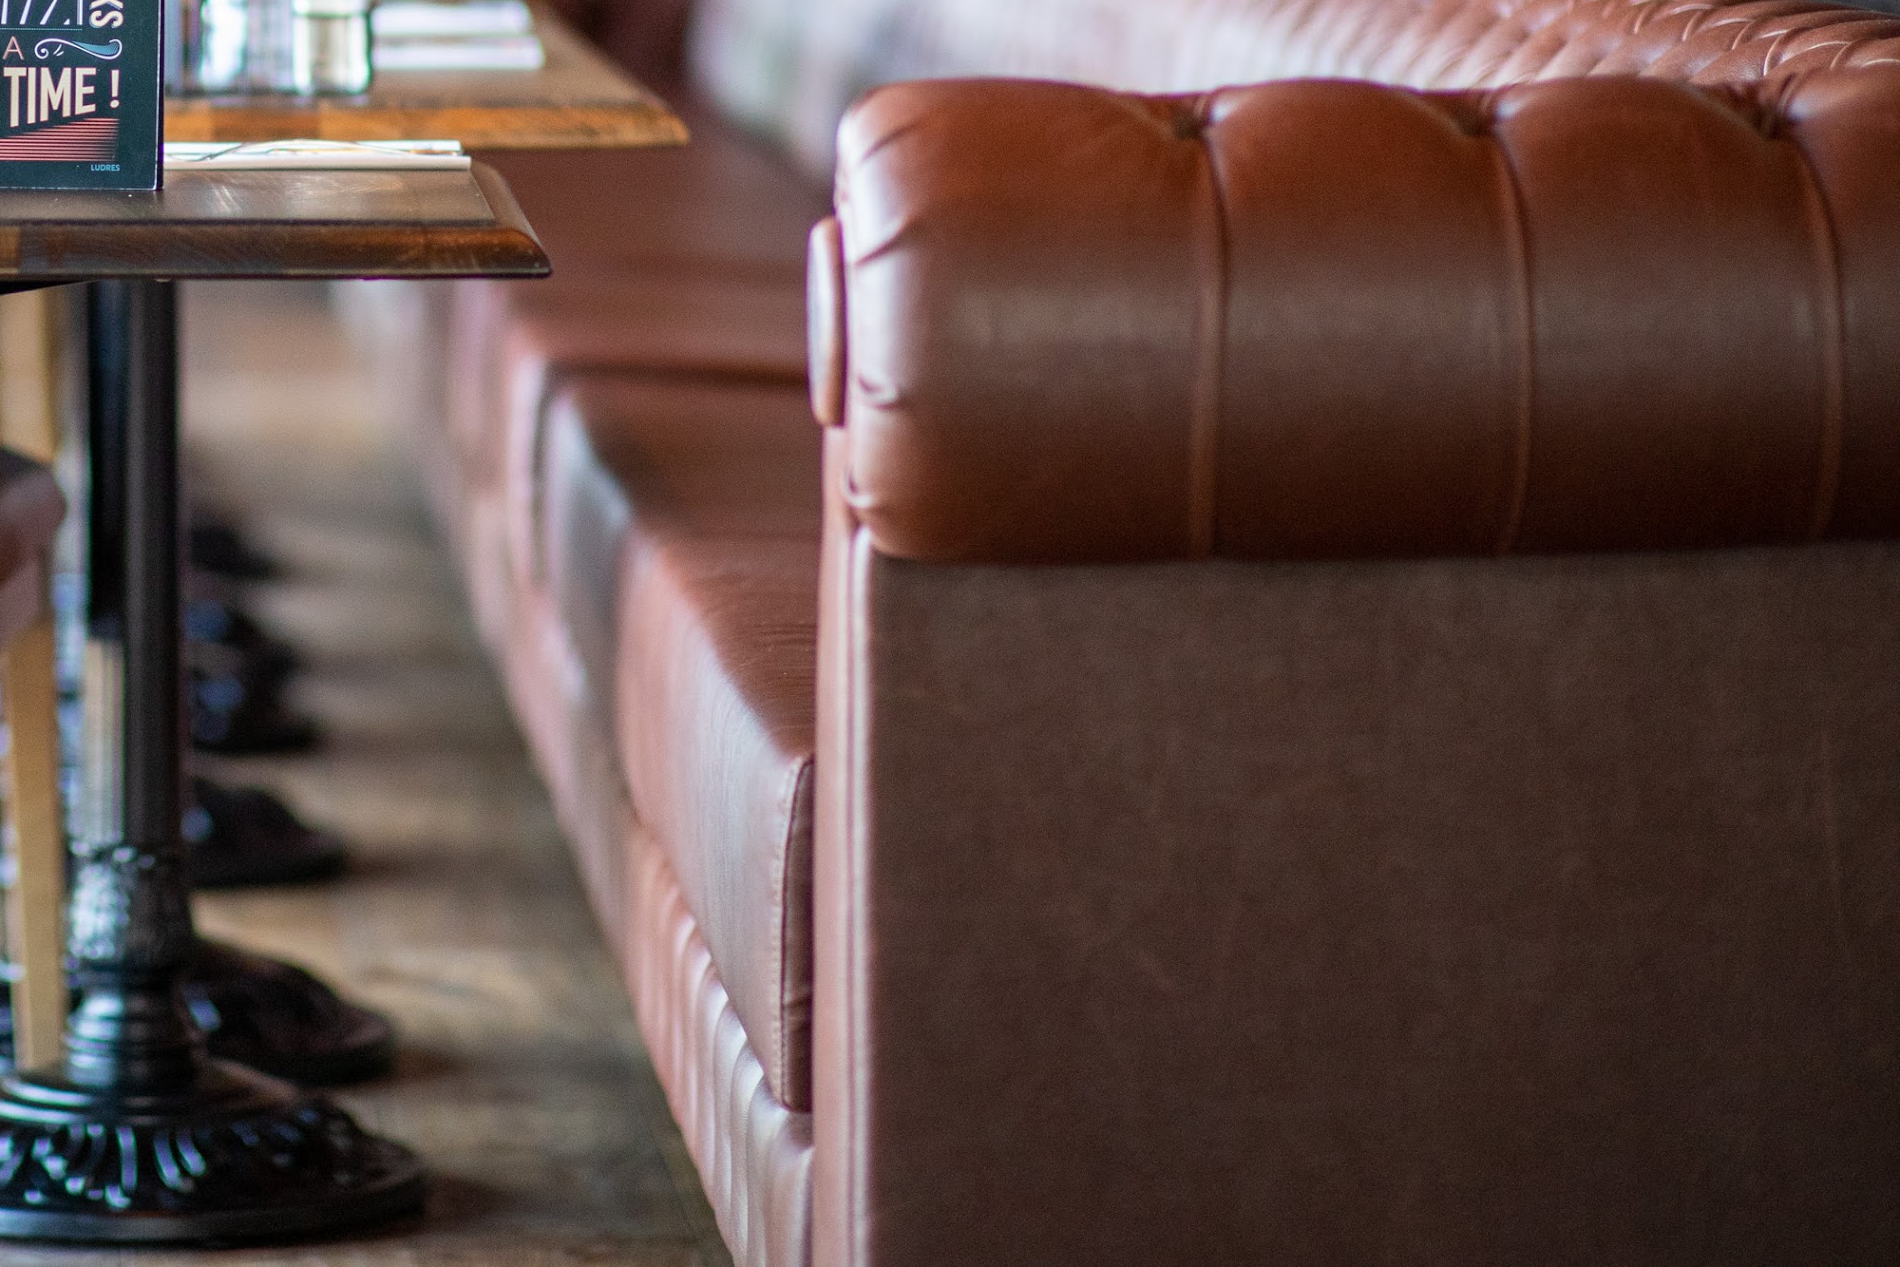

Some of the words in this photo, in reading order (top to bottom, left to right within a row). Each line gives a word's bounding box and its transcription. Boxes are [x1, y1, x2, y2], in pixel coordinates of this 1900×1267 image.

[2, 36, 24, 60] A
[3, 66, 97, 127] TIME
[90, 164, 120, 172] LUDRES
